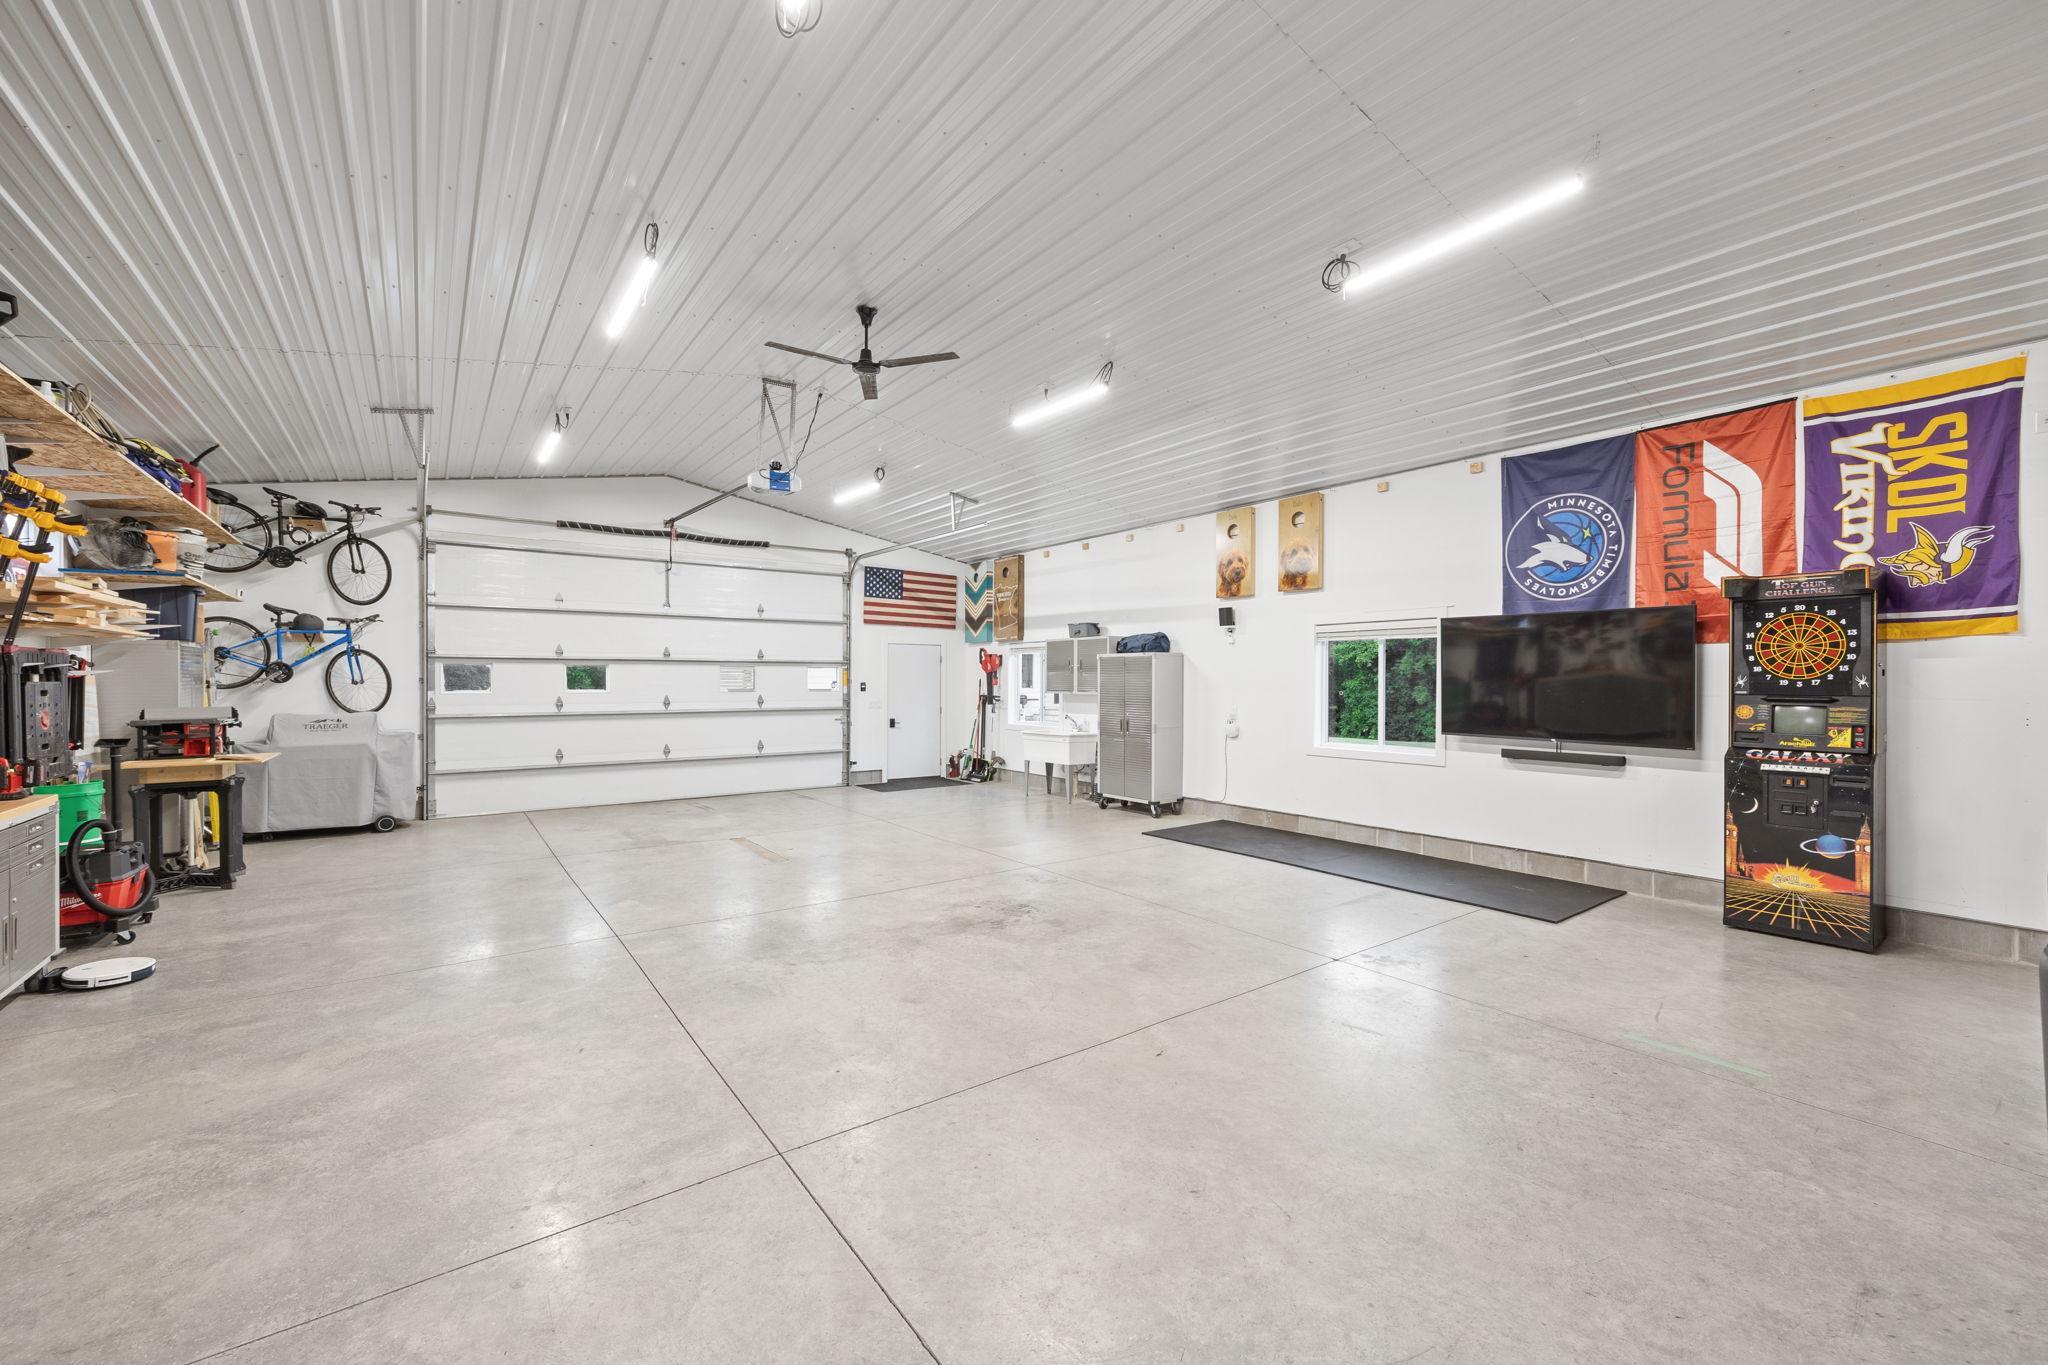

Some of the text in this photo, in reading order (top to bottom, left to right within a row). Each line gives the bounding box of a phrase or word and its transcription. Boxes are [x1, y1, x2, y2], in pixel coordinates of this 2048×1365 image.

[1663, 441, 1696, 592] Formula
[1886, 411, 1968, 534] SKOL
[1524, 498, 1618, 596] MINNESOTA TIMBERWOLVES
[1764, 587, 1835, 597] CHALLENGE
[1745, 749, 1852, 764] GALAXY
